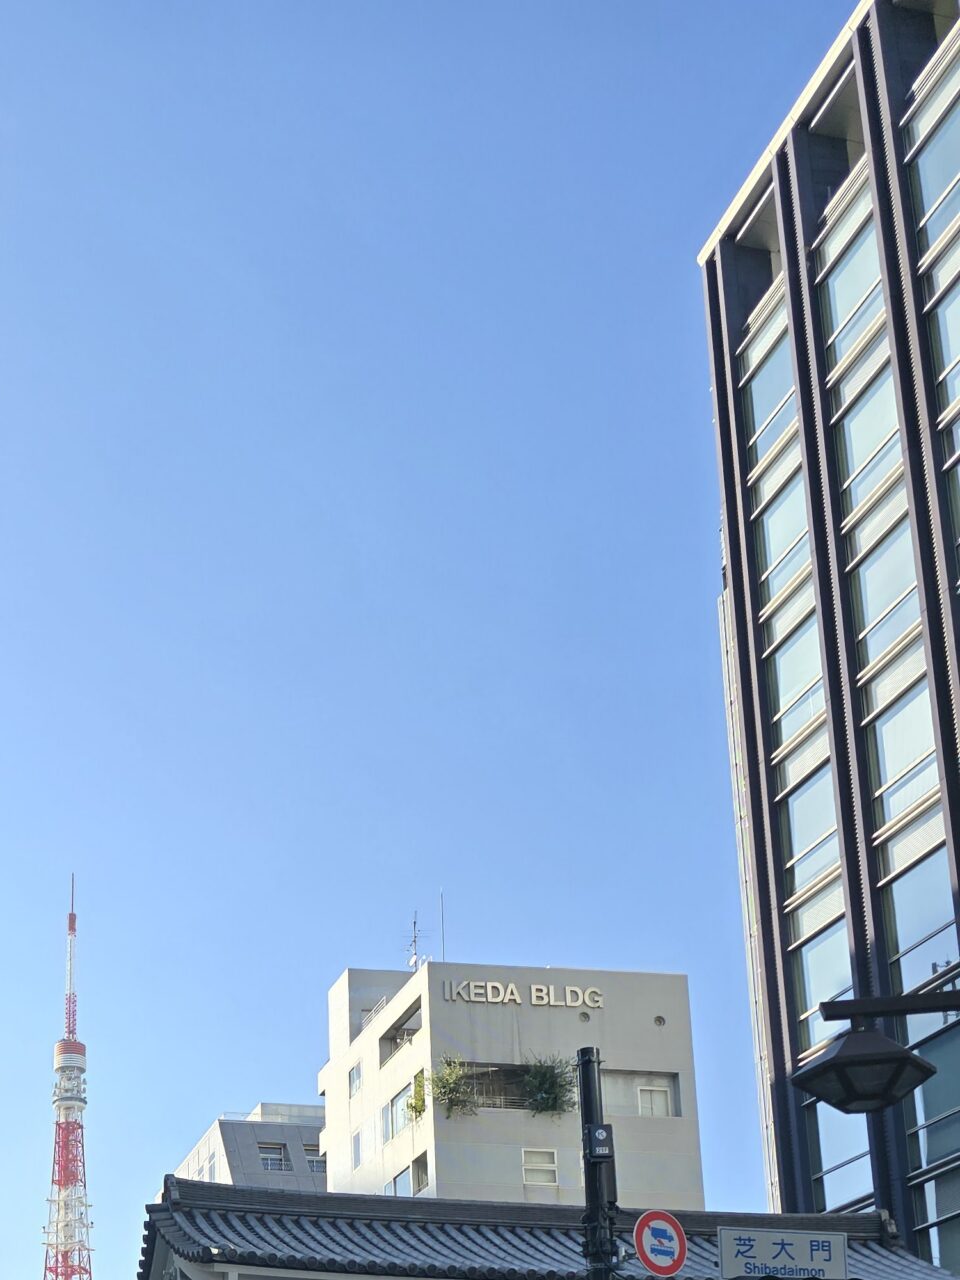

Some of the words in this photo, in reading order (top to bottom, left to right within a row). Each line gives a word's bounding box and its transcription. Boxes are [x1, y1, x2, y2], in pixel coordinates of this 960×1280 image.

[443, 981, 522, 1004] IKEDA
[531, 984, 604, 1009] BLDG
[733, 1236, 832, 1261] 芝大門
[744, 1262, 825, 1277] Shibadaimon
